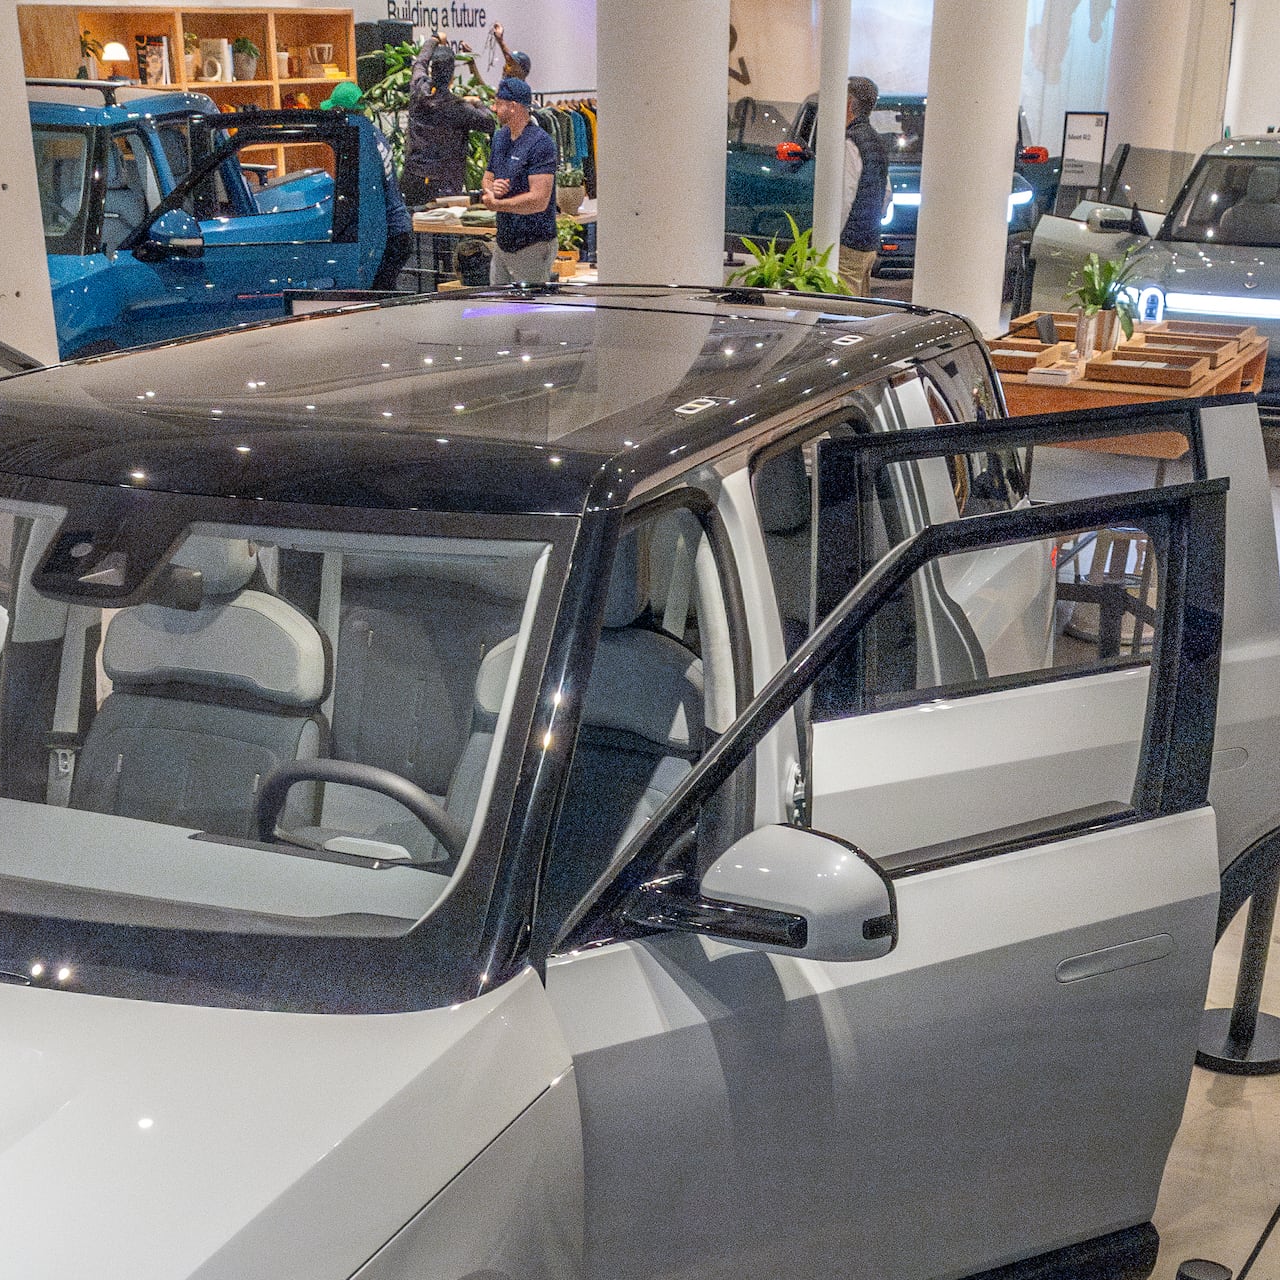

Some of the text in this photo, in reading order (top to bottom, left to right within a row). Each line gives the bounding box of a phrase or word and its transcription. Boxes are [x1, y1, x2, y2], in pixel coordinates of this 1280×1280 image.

[388, 0, 486, 32] Building a future
